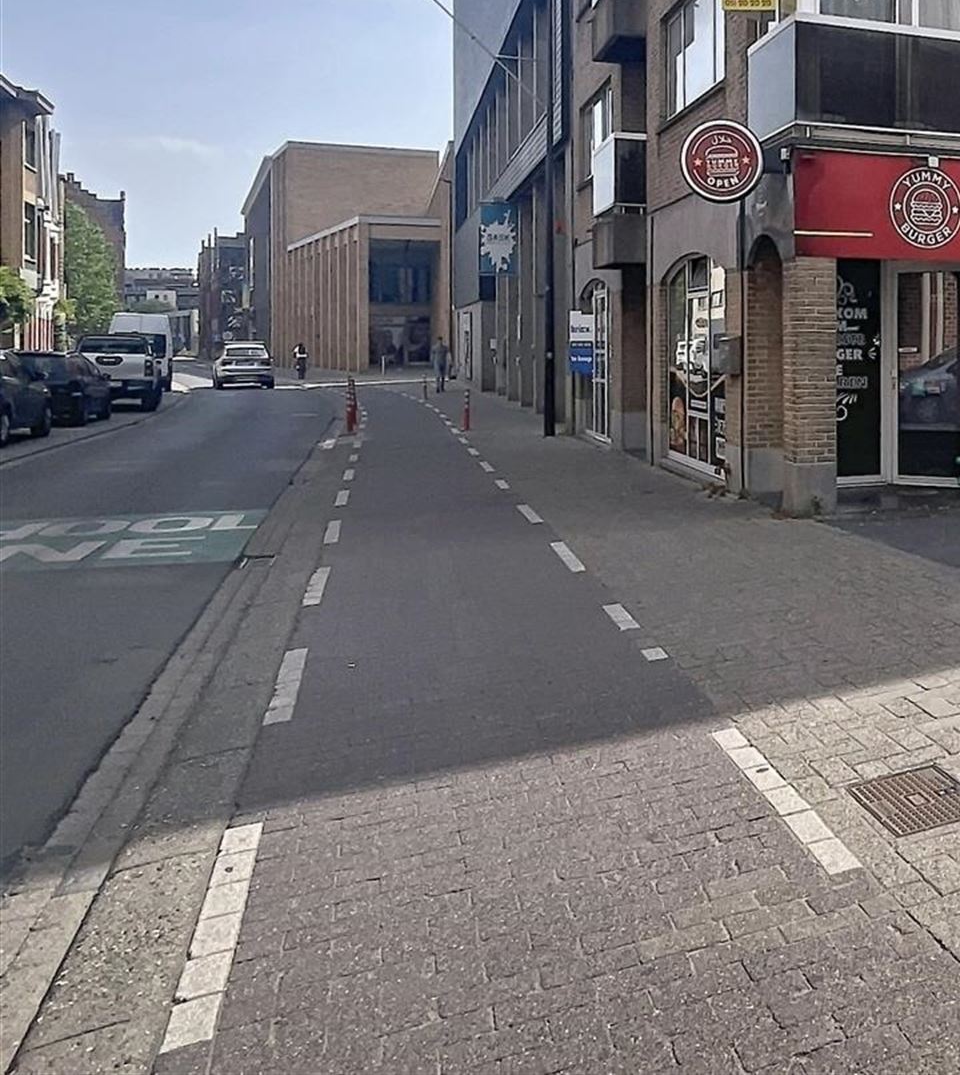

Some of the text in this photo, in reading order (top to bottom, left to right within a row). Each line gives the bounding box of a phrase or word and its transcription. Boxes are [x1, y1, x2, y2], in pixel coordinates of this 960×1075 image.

[707, 176, 739, 188] OPEN
[902, 171, 951, 189] YUMMY
[900, 222, 952, 244] BURGER
